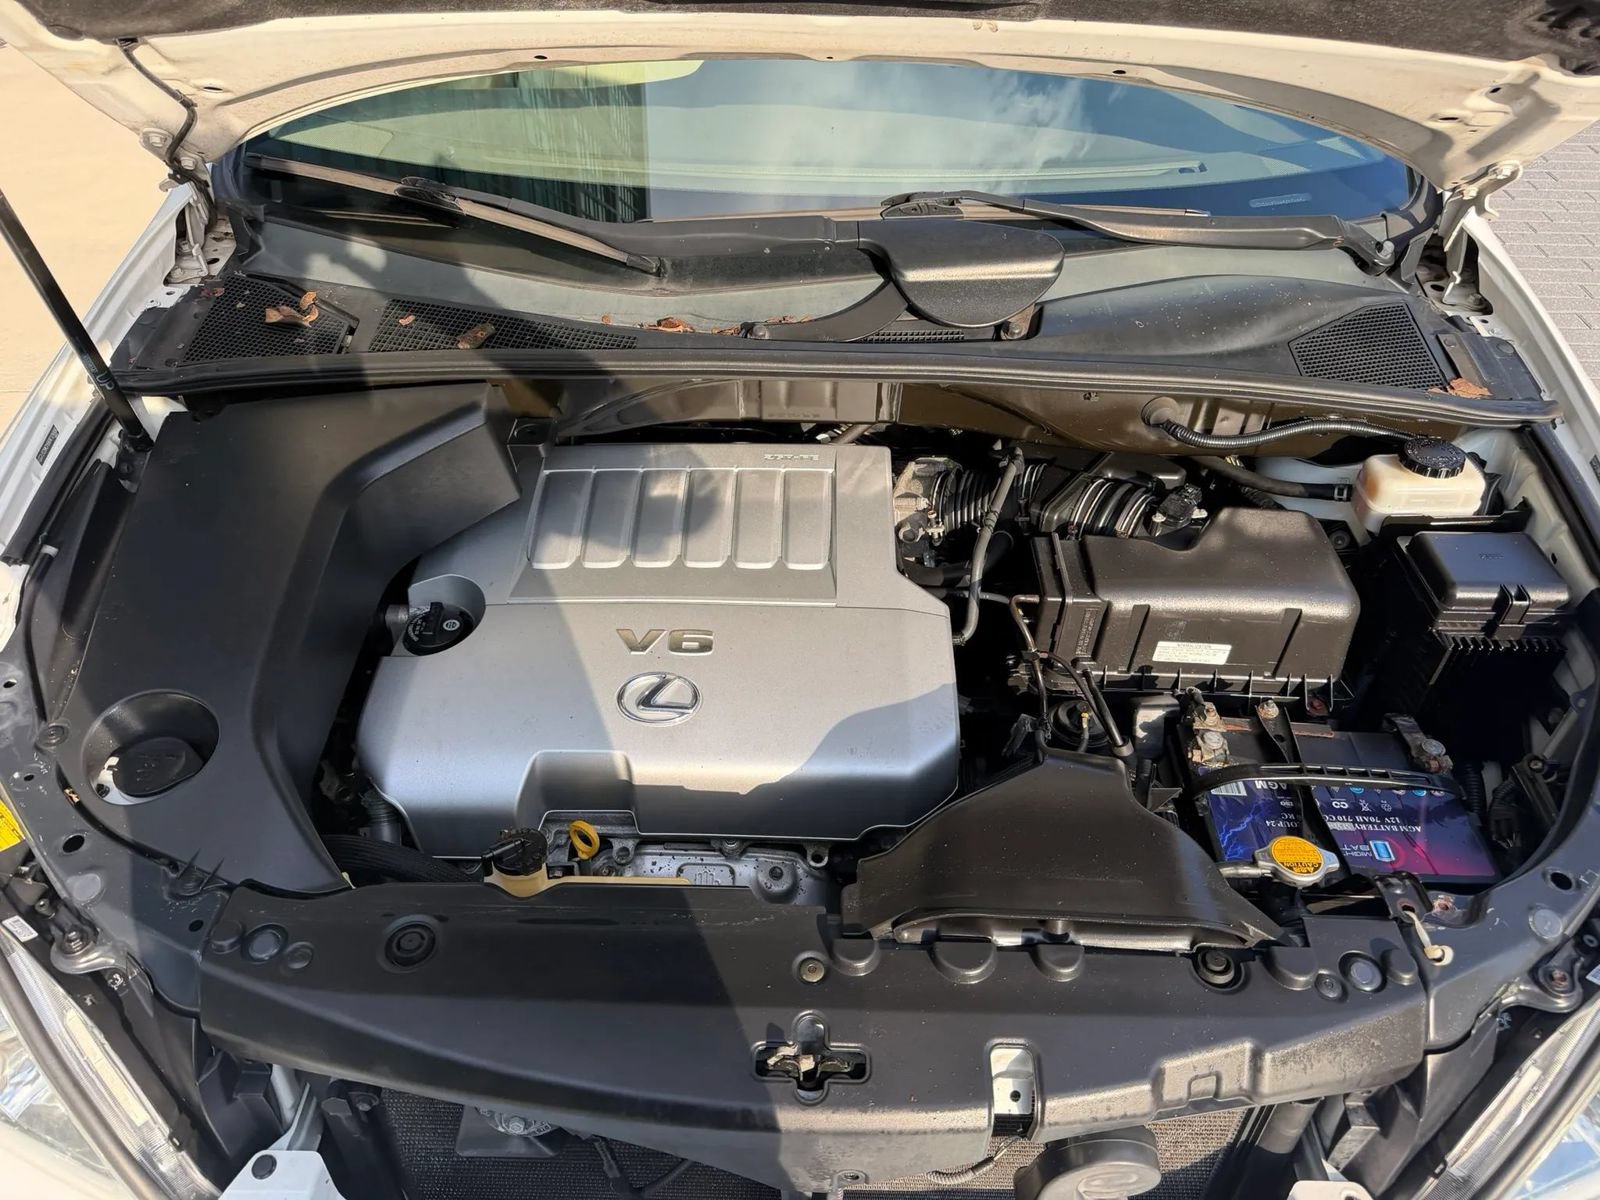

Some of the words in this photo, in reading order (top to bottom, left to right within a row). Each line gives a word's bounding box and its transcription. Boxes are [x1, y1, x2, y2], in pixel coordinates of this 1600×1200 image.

[95, 371, 115, 391] UP
[615, 628, 714, 656] V6
[1255, 780, 1287, 790] AGM
[1355, 815, 1381, 823] 70AH
[1354, 823, 1398, 832] BATTERY
